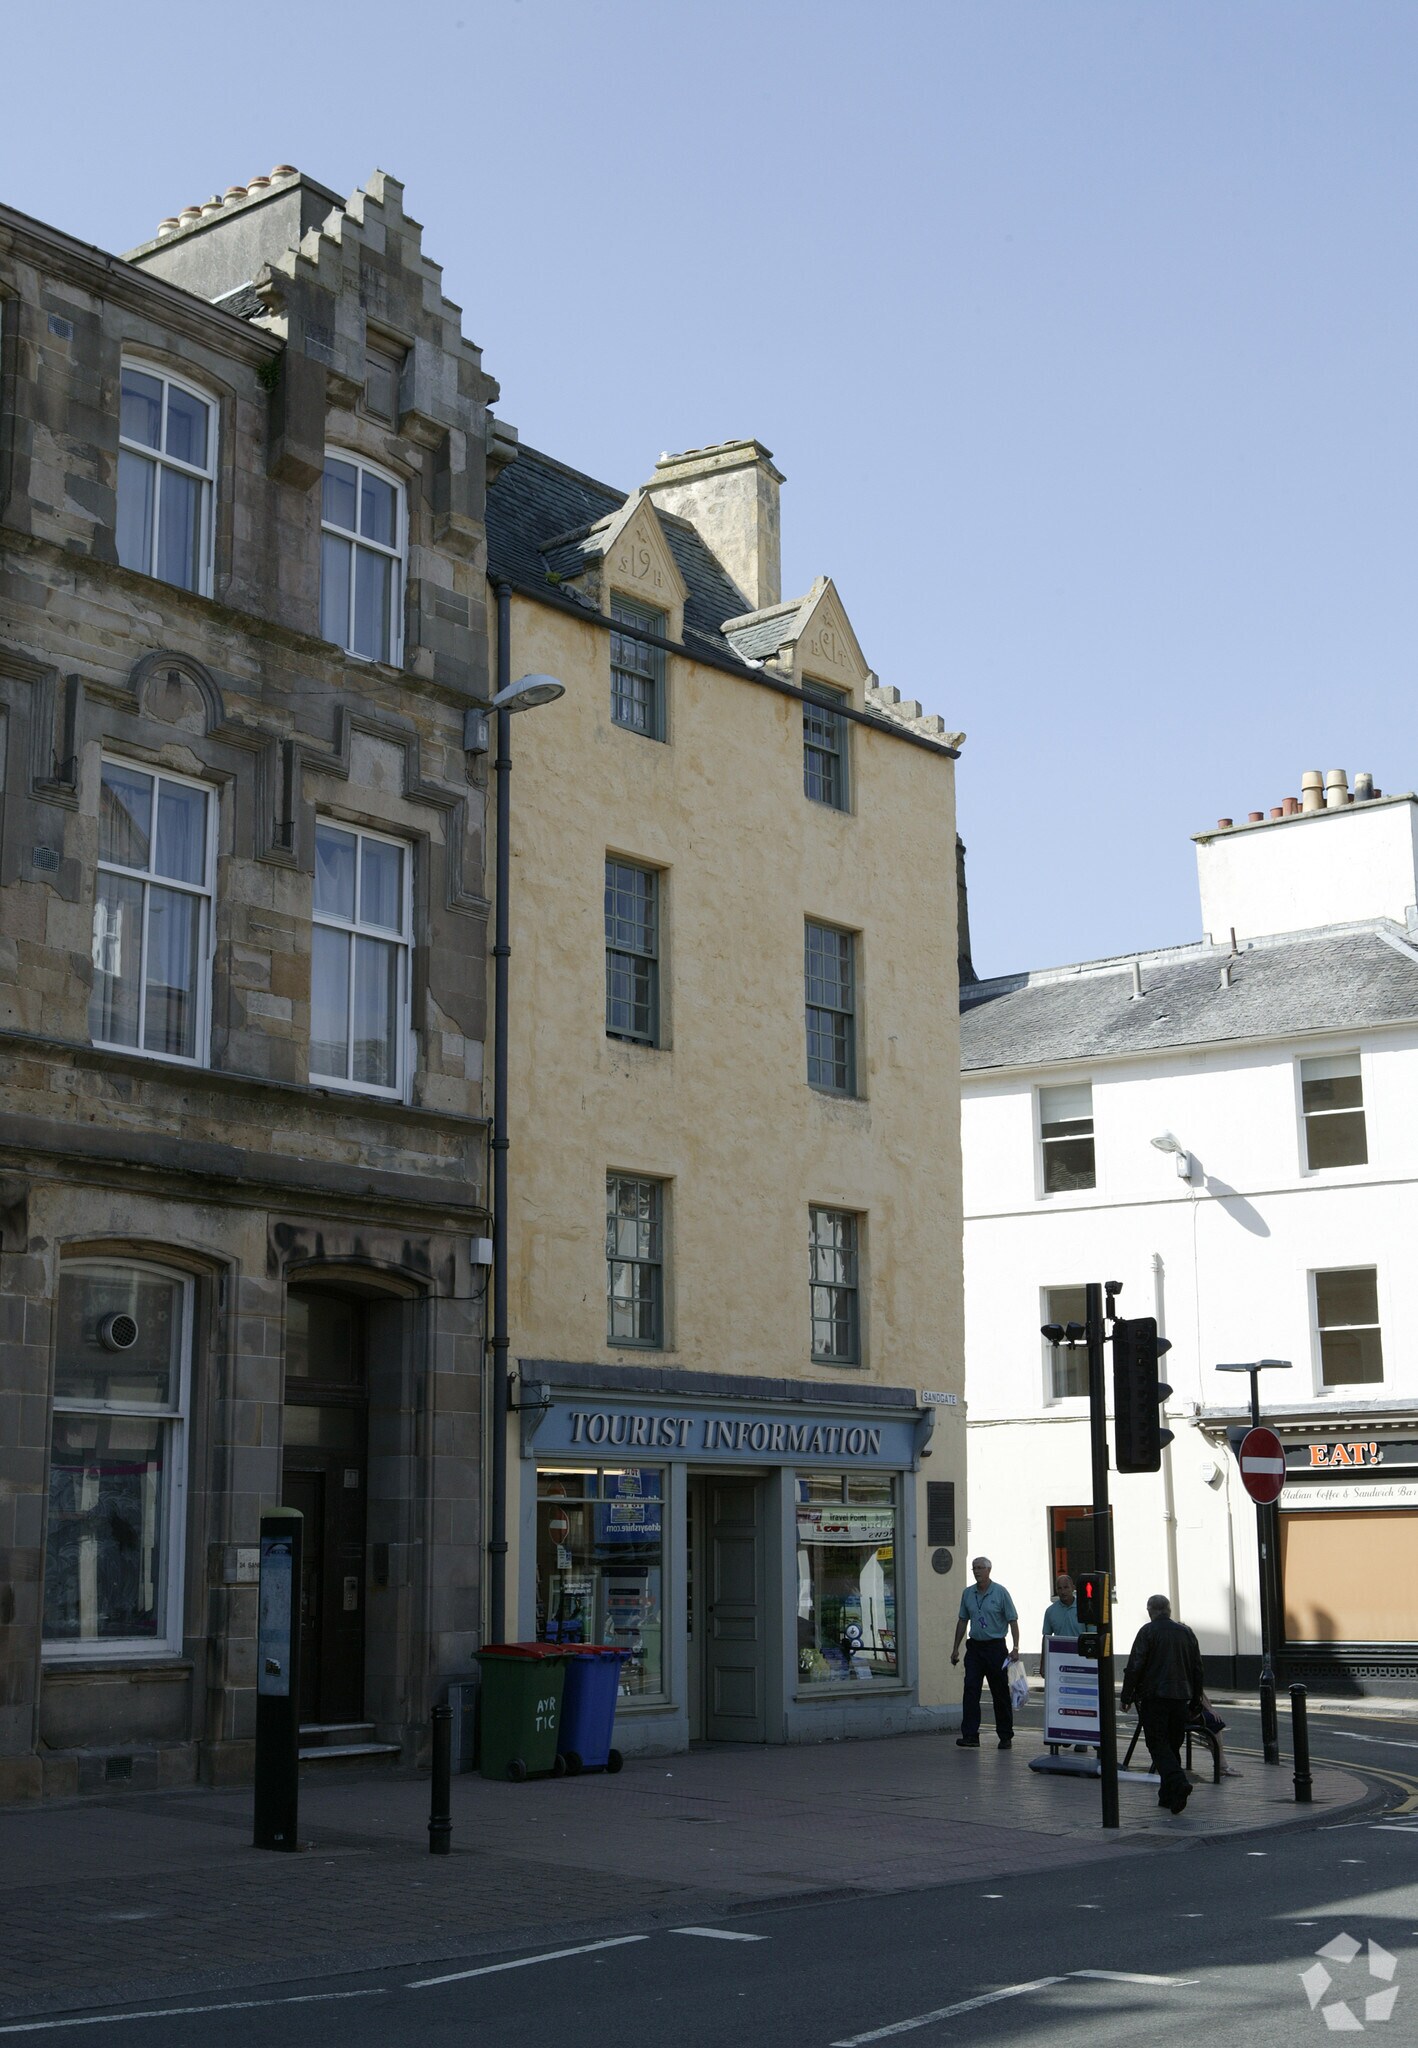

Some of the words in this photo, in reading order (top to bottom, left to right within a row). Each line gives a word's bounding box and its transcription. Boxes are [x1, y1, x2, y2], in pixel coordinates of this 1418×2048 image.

[923, 1391, 956, 1405] SANDGATE
[571, 1412, 694, 1447] TOURIST
[703, 1420, 883, 1455] INFORMATION
[1308, 1442, 1378, 1466] EAT!
[1281, 1488, 1312, 1500] Italian
[1315, 1488, 1340, 1501] Coffee
[1342, 1488, 1350, 1499] &
[1353, 1486, 1394, 1498] Sandwich
[1397, 1485, 1417, 1497] Bar
[536, 1696, 556, 1714] AYR
[535, 1714, 555, 1732] TIC
